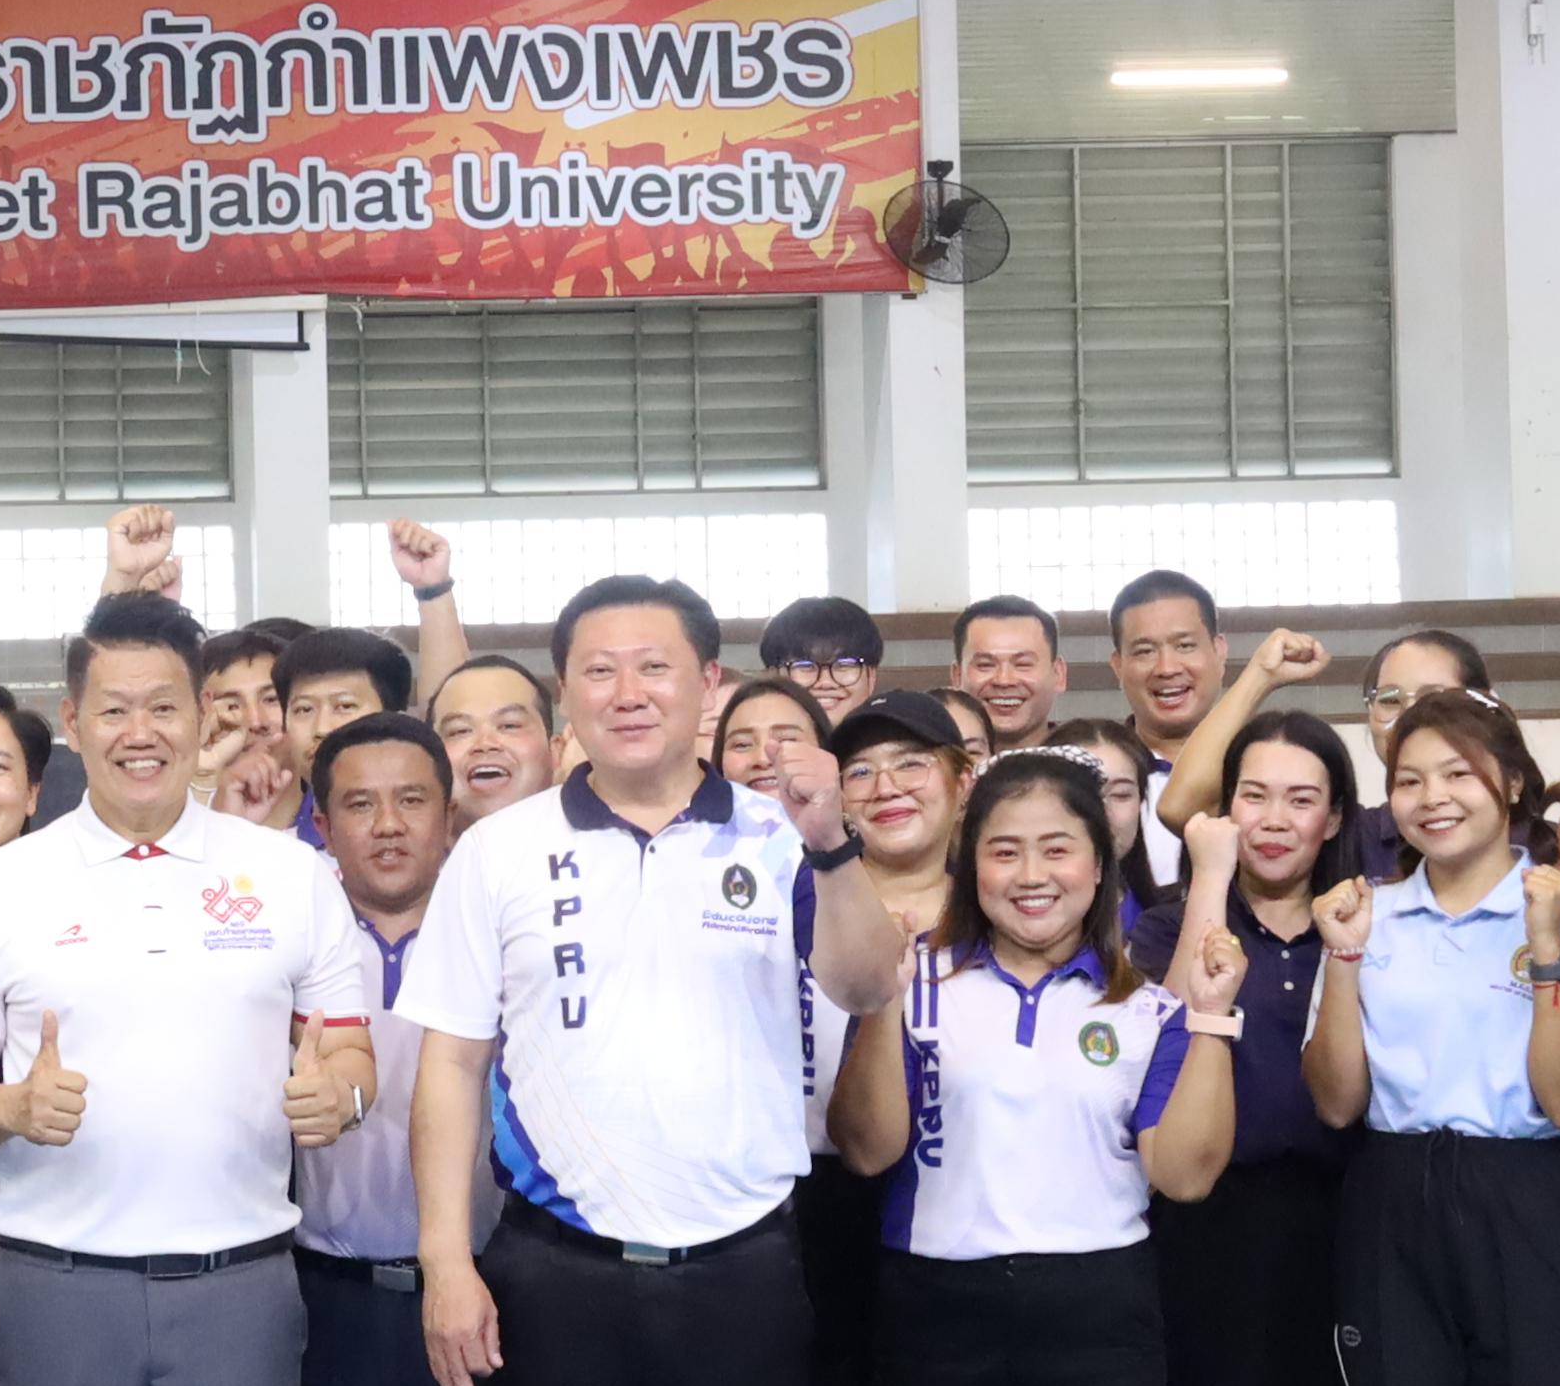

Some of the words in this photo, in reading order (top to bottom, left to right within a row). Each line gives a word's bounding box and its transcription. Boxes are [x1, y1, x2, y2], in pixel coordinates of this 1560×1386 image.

[86, 163, 424, 243] Rajabhat
[460, 157, 834, 231] University
[547, 849, 587, 1030] KPRU
[917, 1039, 944, 1168] KPRU
